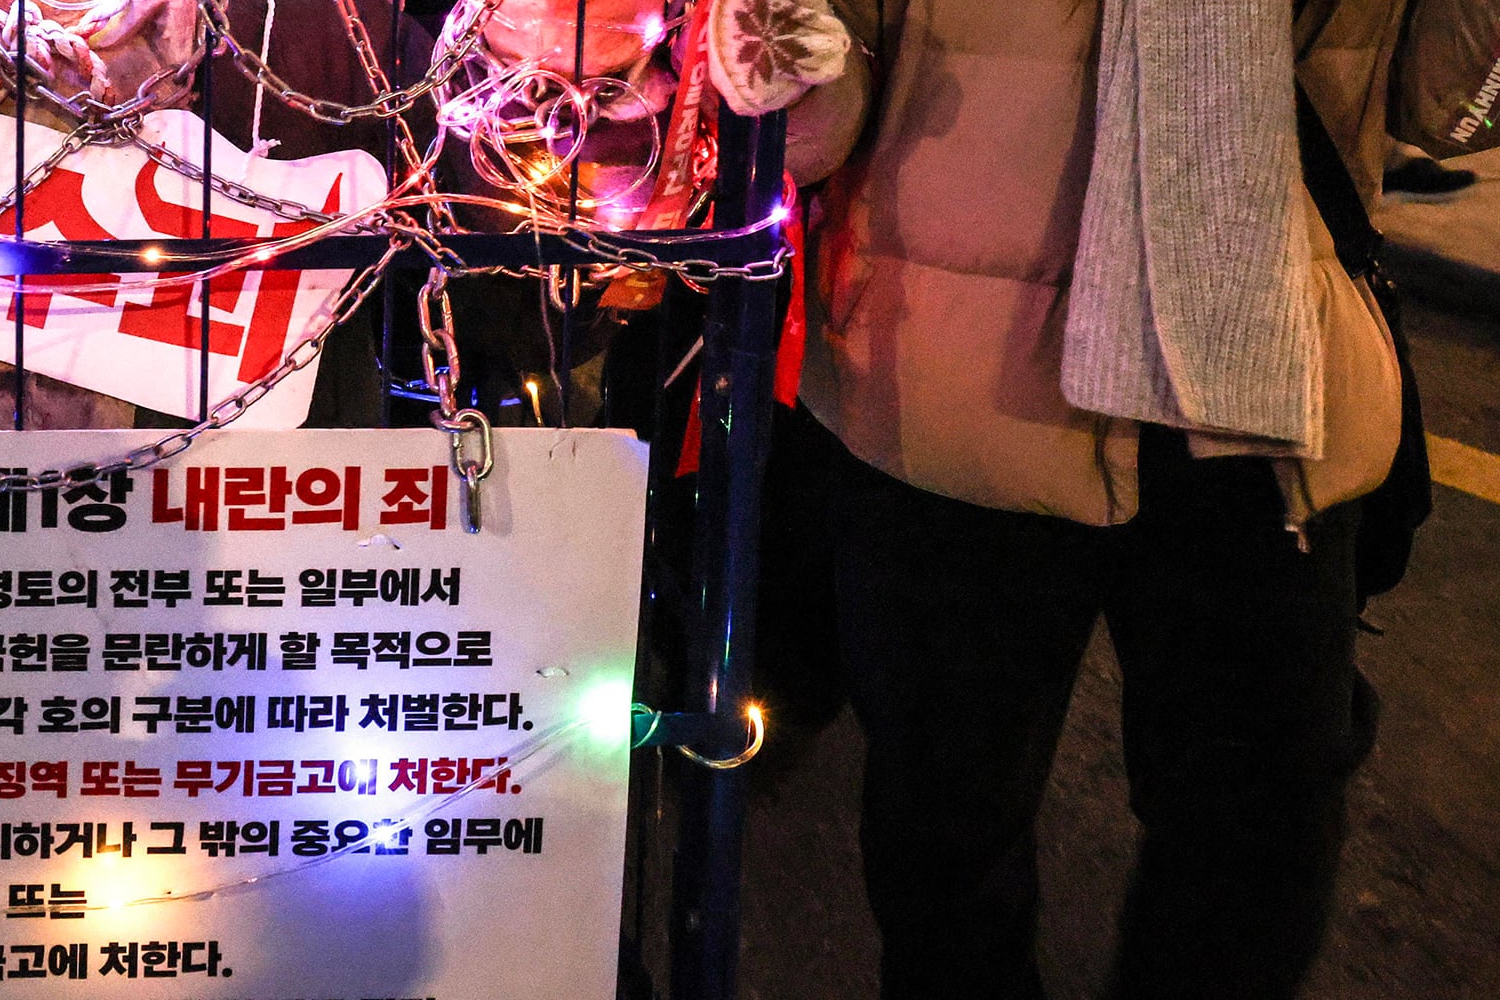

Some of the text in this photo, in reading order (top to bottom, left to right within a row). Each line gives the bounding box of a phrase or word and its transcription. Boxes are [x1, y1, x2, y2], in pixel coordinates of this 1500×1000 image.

[152, 466, 361, 531] 내란의
[380, 466, 448, 530] 죄
[110, 570, 191, 608] 전부
[203, 570, 285, 607] 또는
[299, 568, 460, 607] 일부에서
[102, 632, 267, 671] 문란하게
[280, 632, 320, 670] 할
[331, 631, 492, 669] 목적으로
[38, 696, 120, 733] 호의
[133, 696, 255, 733] 구분에
[267, 695, 349, 732] 따라
[359, 693, 533, 731] 처벌한다.
[81, 761, 162, 797] 또는
[173, 760, 376, 797] 무기금고에
[388, 757, 522, 795] 처한다.
[147, 822, 186, 854] 그
[200, 821, 279, 857] 밖의
[425, 818, 543, 855] 임무에
[4, 884, 87, 919] 또는
[99, 941, 232, 978] 처한다.
